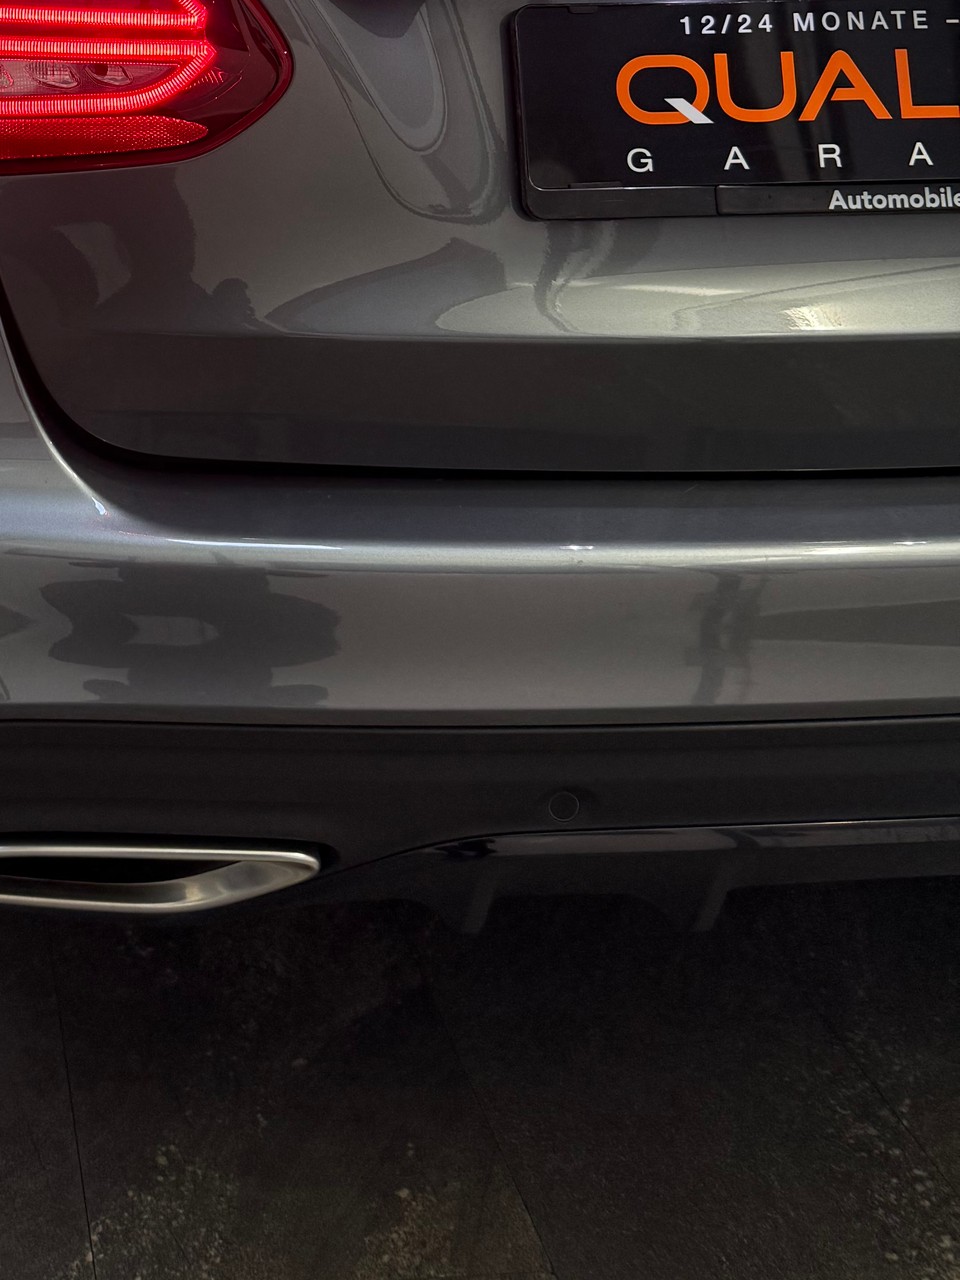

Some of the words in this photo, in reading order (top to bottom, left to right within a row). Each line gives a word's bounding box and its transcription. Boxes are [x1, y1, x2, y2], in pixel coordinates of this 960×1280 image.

[679, 13, 773, 35] 12/24
[792, 9, 929, 33] MONATE
[615, 48, 960, 126] QUAL
